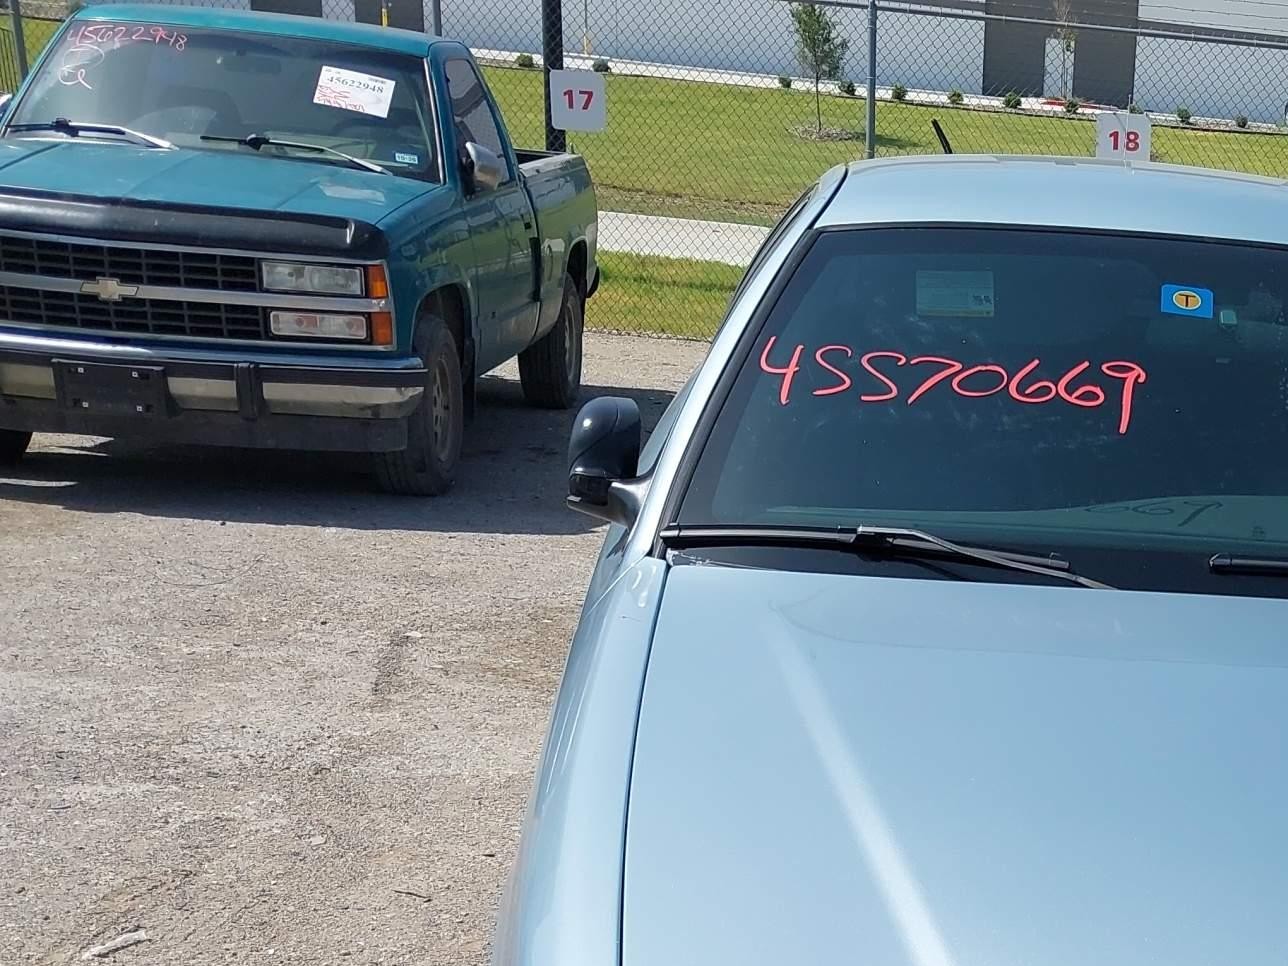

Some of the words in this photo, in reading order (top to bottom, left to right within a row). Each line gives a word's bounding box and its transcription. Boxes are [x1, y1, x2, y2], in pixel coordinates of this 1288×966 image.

[563, 89, 593, 110] 17
[1109, 131, 1140, 151] 18
[1178, 294, 1196, 308] T
[760, 336, 1147, 434] 45570669
